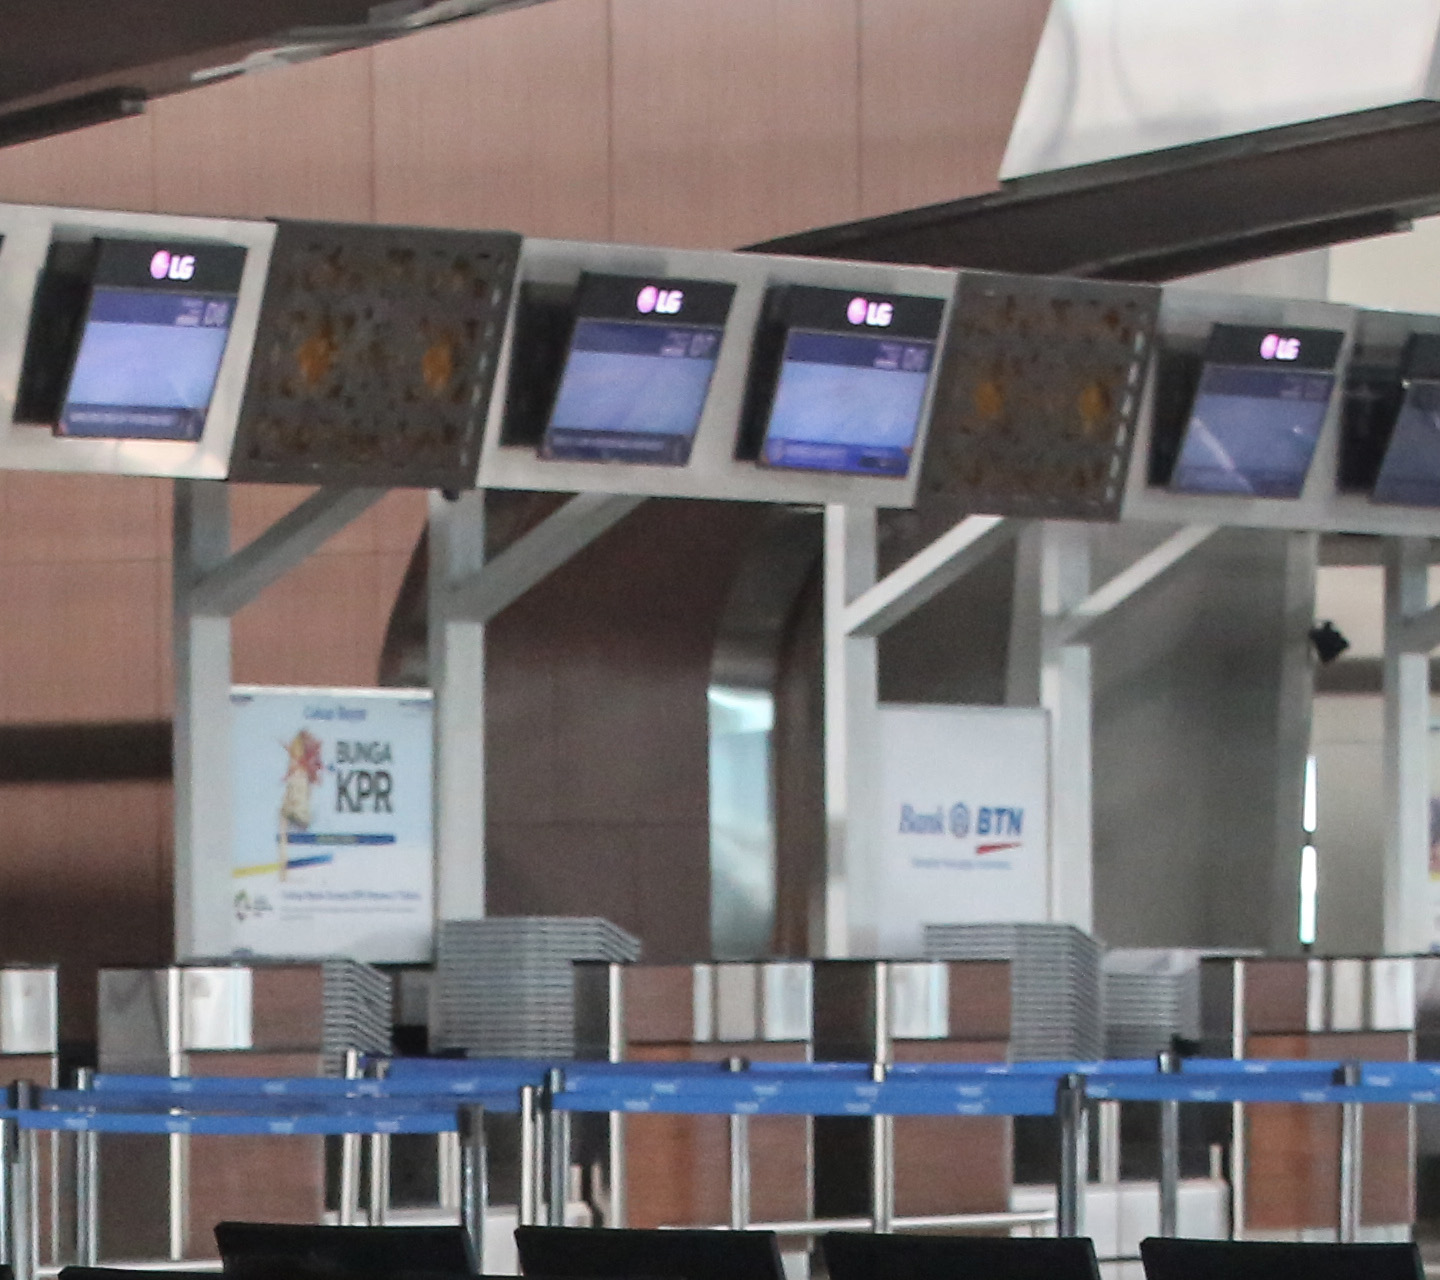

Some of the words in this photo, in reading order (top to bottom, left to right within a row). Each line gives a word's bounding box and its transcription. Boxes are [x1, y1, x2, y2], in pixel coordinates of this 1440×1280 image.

[169, 255, 195, 281] LG
[655, 290, 683, 314] LG
[866, 302, 894, 326] LG
[336, 740, 393, 764] BUNGA
[335, 769, 393, 814] KPR
[976, 806, 1024, 835] BTN
